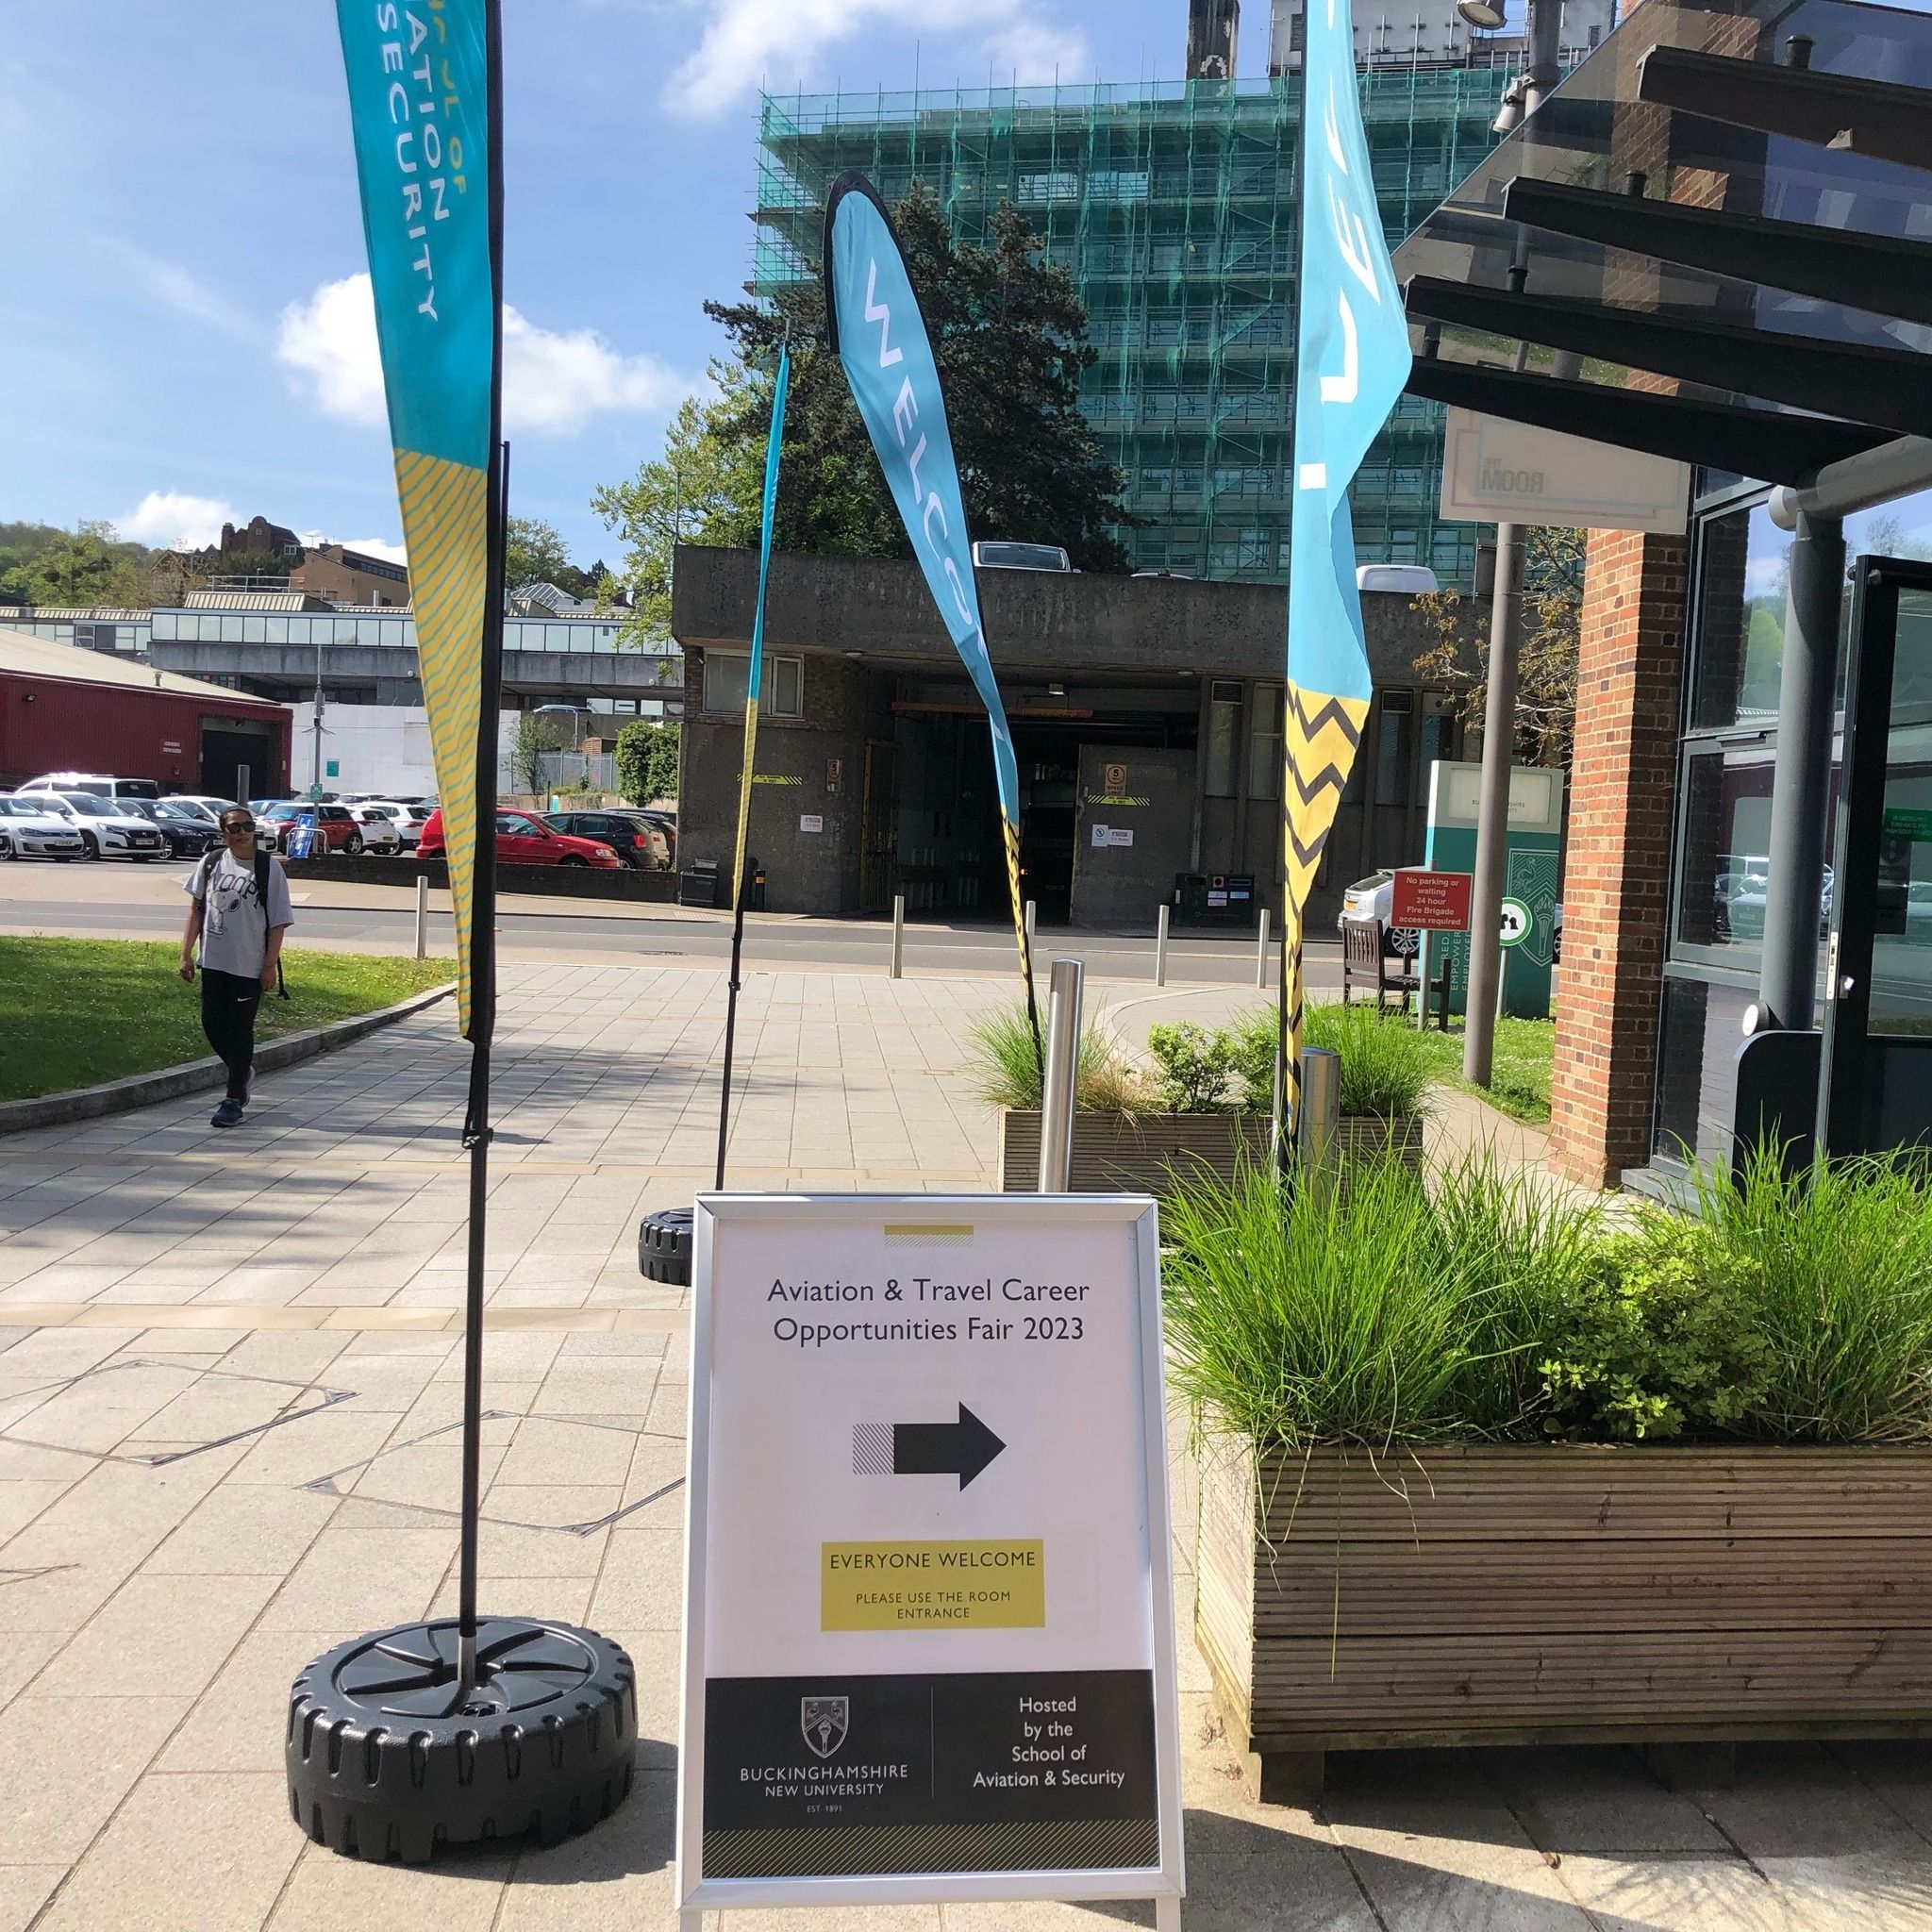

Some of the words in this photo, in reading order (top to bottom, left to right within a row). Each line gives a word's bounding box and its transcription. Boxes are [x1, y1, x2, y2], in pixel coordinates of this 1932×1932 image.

[405, 0, 450, 221] ATION
[377, 2, 438, 322] SECURITY
[864, 256, 988, 662] WELCO
[1113, 769, 1120, 777] 5
[1418, 888, 1446, 896] waiting
[1419, 877, 1449, 888] parking
[1424, 907, 1455, 916] Brigade
[1427, 917, 1461, 925] required
[1450, 931, 1461, 991] EMPOWER
[767, 1277, 874, 1302] Aviation
[883, 1277, 904, 1302] &
[912, 1277, 991, 1302] Travel
[1001, 1277, 1091, 1302] Career
[773, 1316, 958, 1348] Opportunities
[967, 1316, 1014, 1341] Fair
[1023, 1315, 1085, 1341] 2023
[829, 1552, 932, 1570] EVERYONE
[938, 1550, 1037, 1568] WELCOME
[855, 1591, 903, 1605] PLEASE
[908, 1591, 932, 1604] USE
[937, 1591, 963, 1604] THE
[968, 1590, 1011, 1603] ROOM
[896, 1606, 971, 1620] ENTRANCE
[1019, 1695, 1077, 1714] Hosted
[1024, 1720, 1043, 1742] by
[1047, 1719, 1074, 1738] the
[1011, 1743, 1066, 1762] School
[1070, 1742, 1088, 1762] of
[740, 1763, 908, 1782] BUCKINGHAMSHIRE
[973, 1770, 1040, 1788] Aviation
[1044, 1769, 1057, 1787] &
[1061, 1768, 1125, 1790] Security
[765, 1785, 799, 1798] NEW
[804, 1783, 885, 1797] UNIVERSITY
[825, 1804, 842, 1813] 1891
